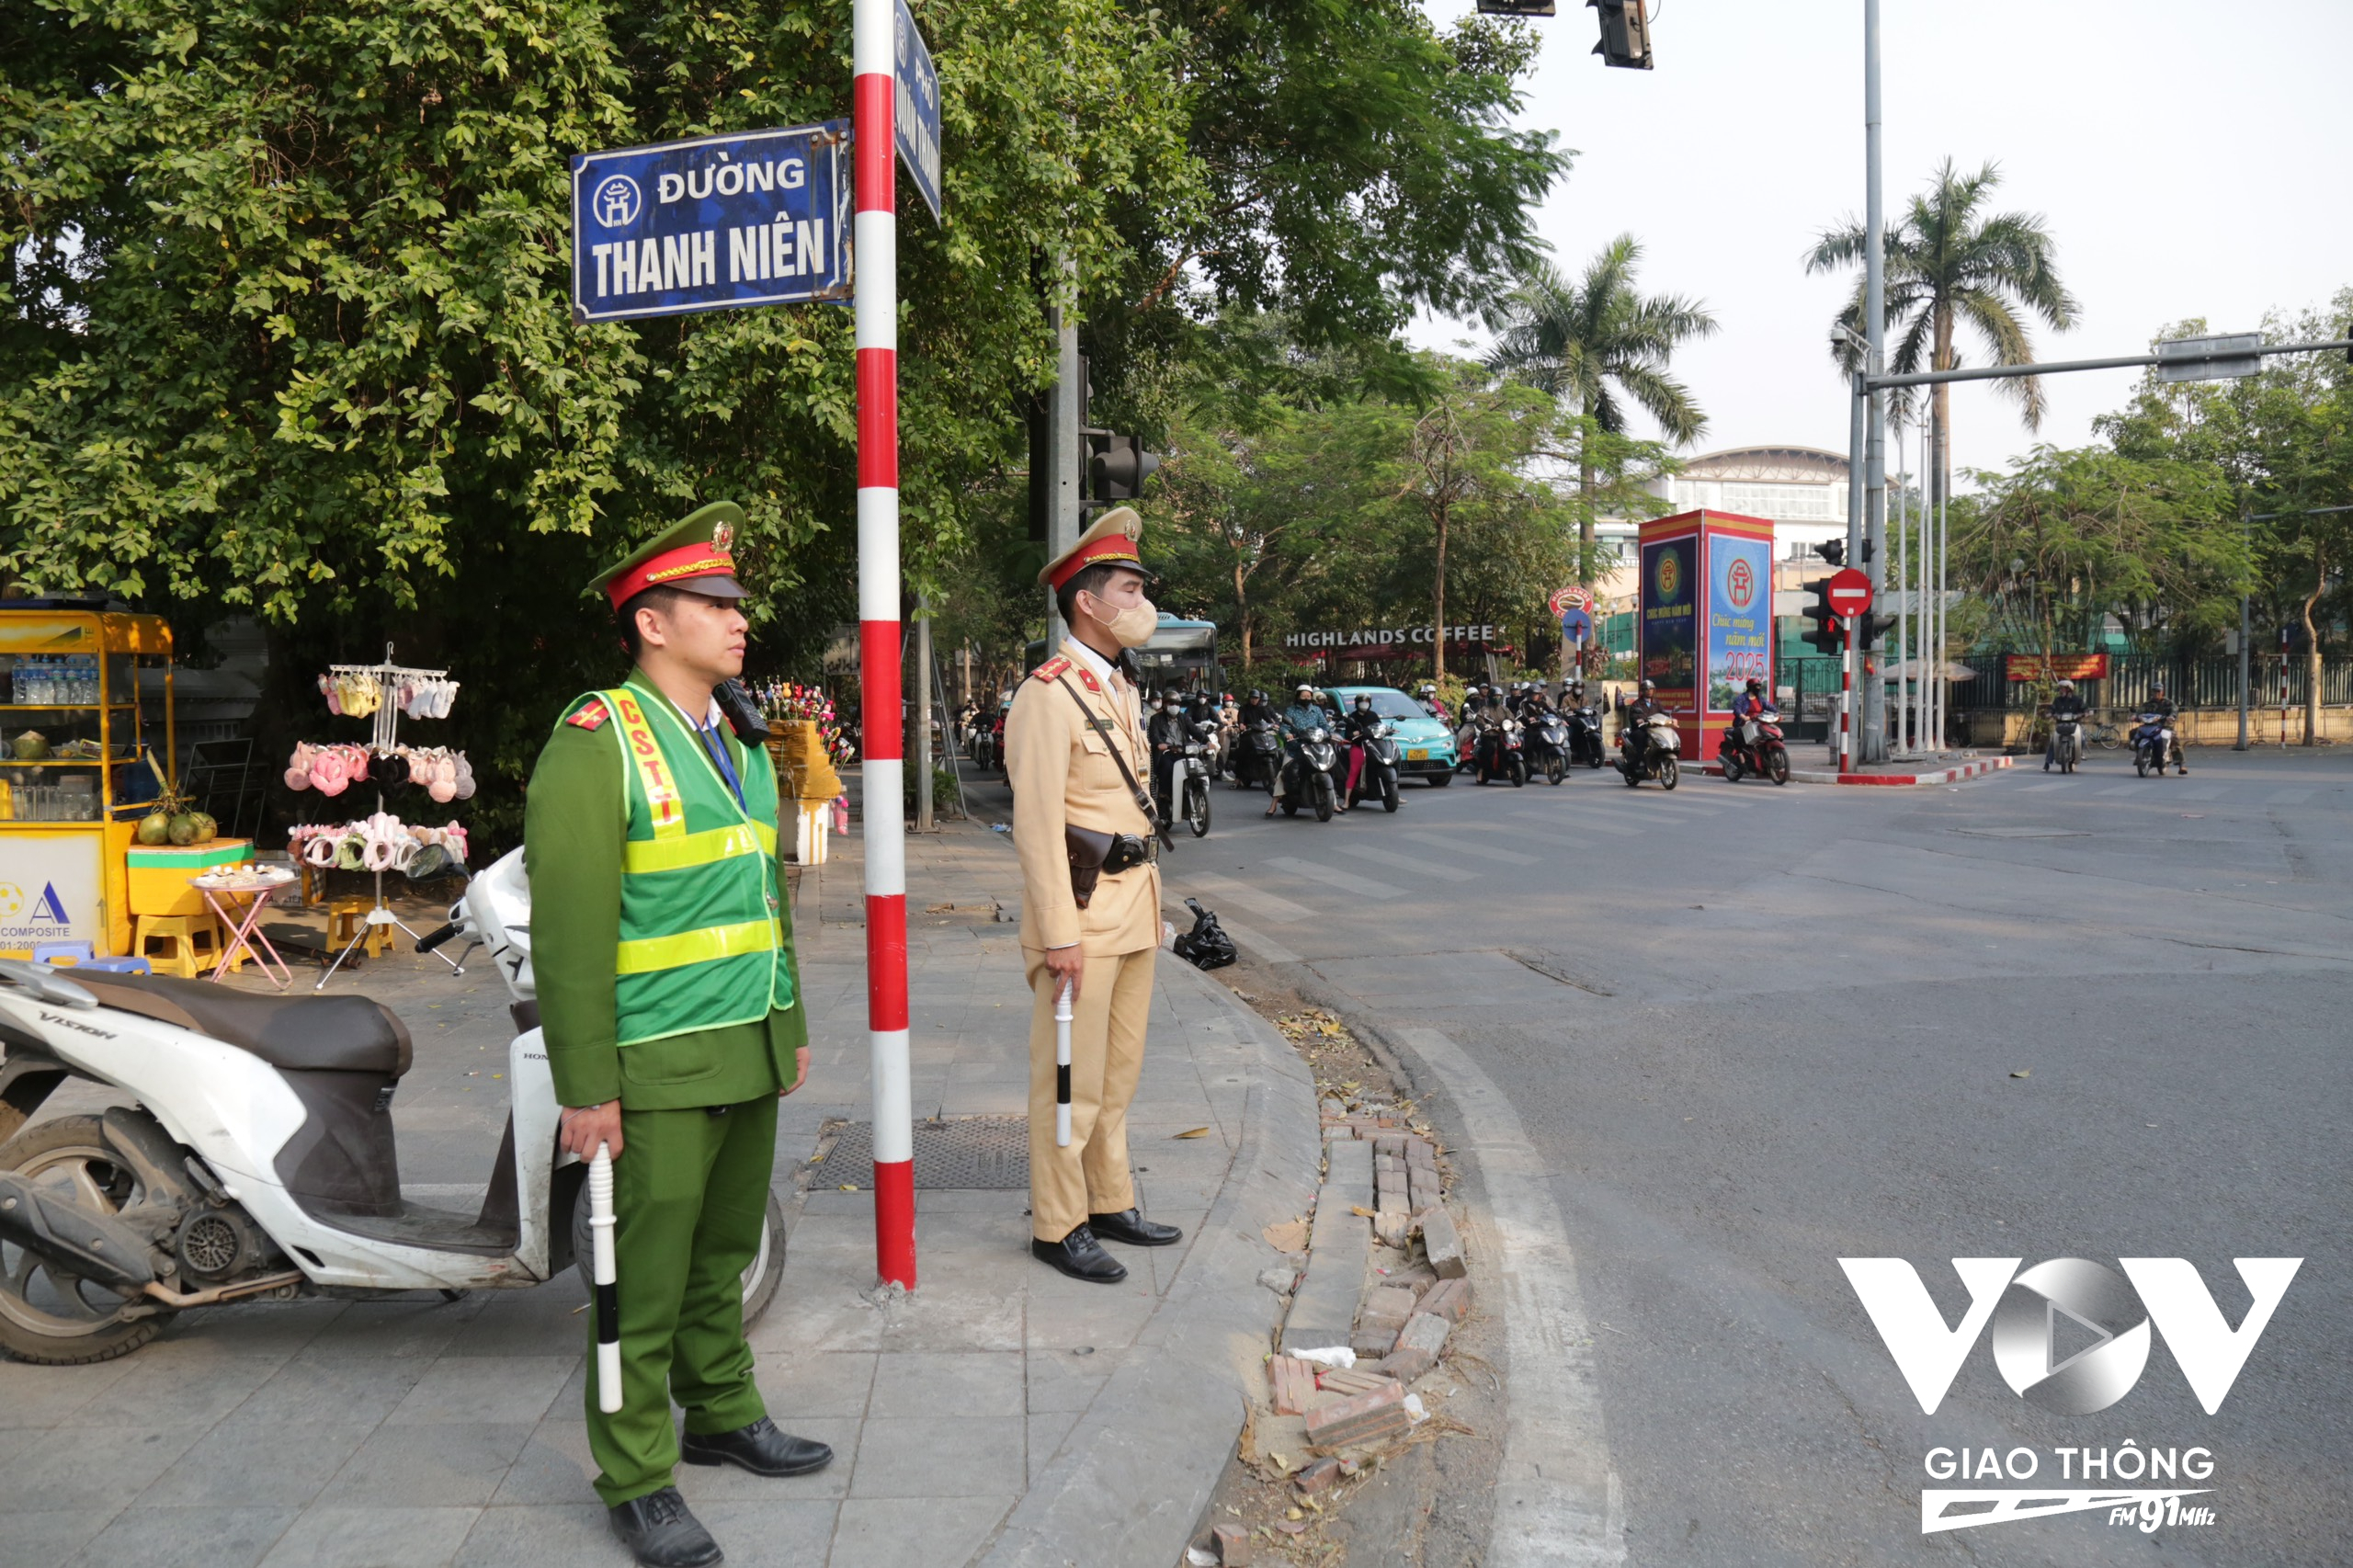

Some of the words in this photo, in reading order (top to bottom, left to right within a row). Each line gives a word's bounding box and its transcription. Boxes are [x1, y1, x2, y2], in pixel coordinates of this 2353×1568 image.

[915, 56, 933, 110] PHỐ
[896, 71, 916, 156] QUÁN
[657, 152, 805, 204] ĐƯỜNG
[592, 230, 716, 298] THANH
[729, 210, 824, 284] NIÊN
[1551, 587, 1591, 602] HIGHLANDS
[1712, 613, 1732, 627] Chúc
[1286, 628, 1405, 647] HIGHLANDS
[1411, 624, 1494, 643] COFFEE
[1725, 631, 1745, 646] năm
[1748, 632, 1765, 647] mới
[1725, 651, 1765, 681] 2025
[619, 699, 672, 823] CSTT
[0, 927, 70, 937] COMPOSITE
[40, 1010, 118, 1040] VISION
